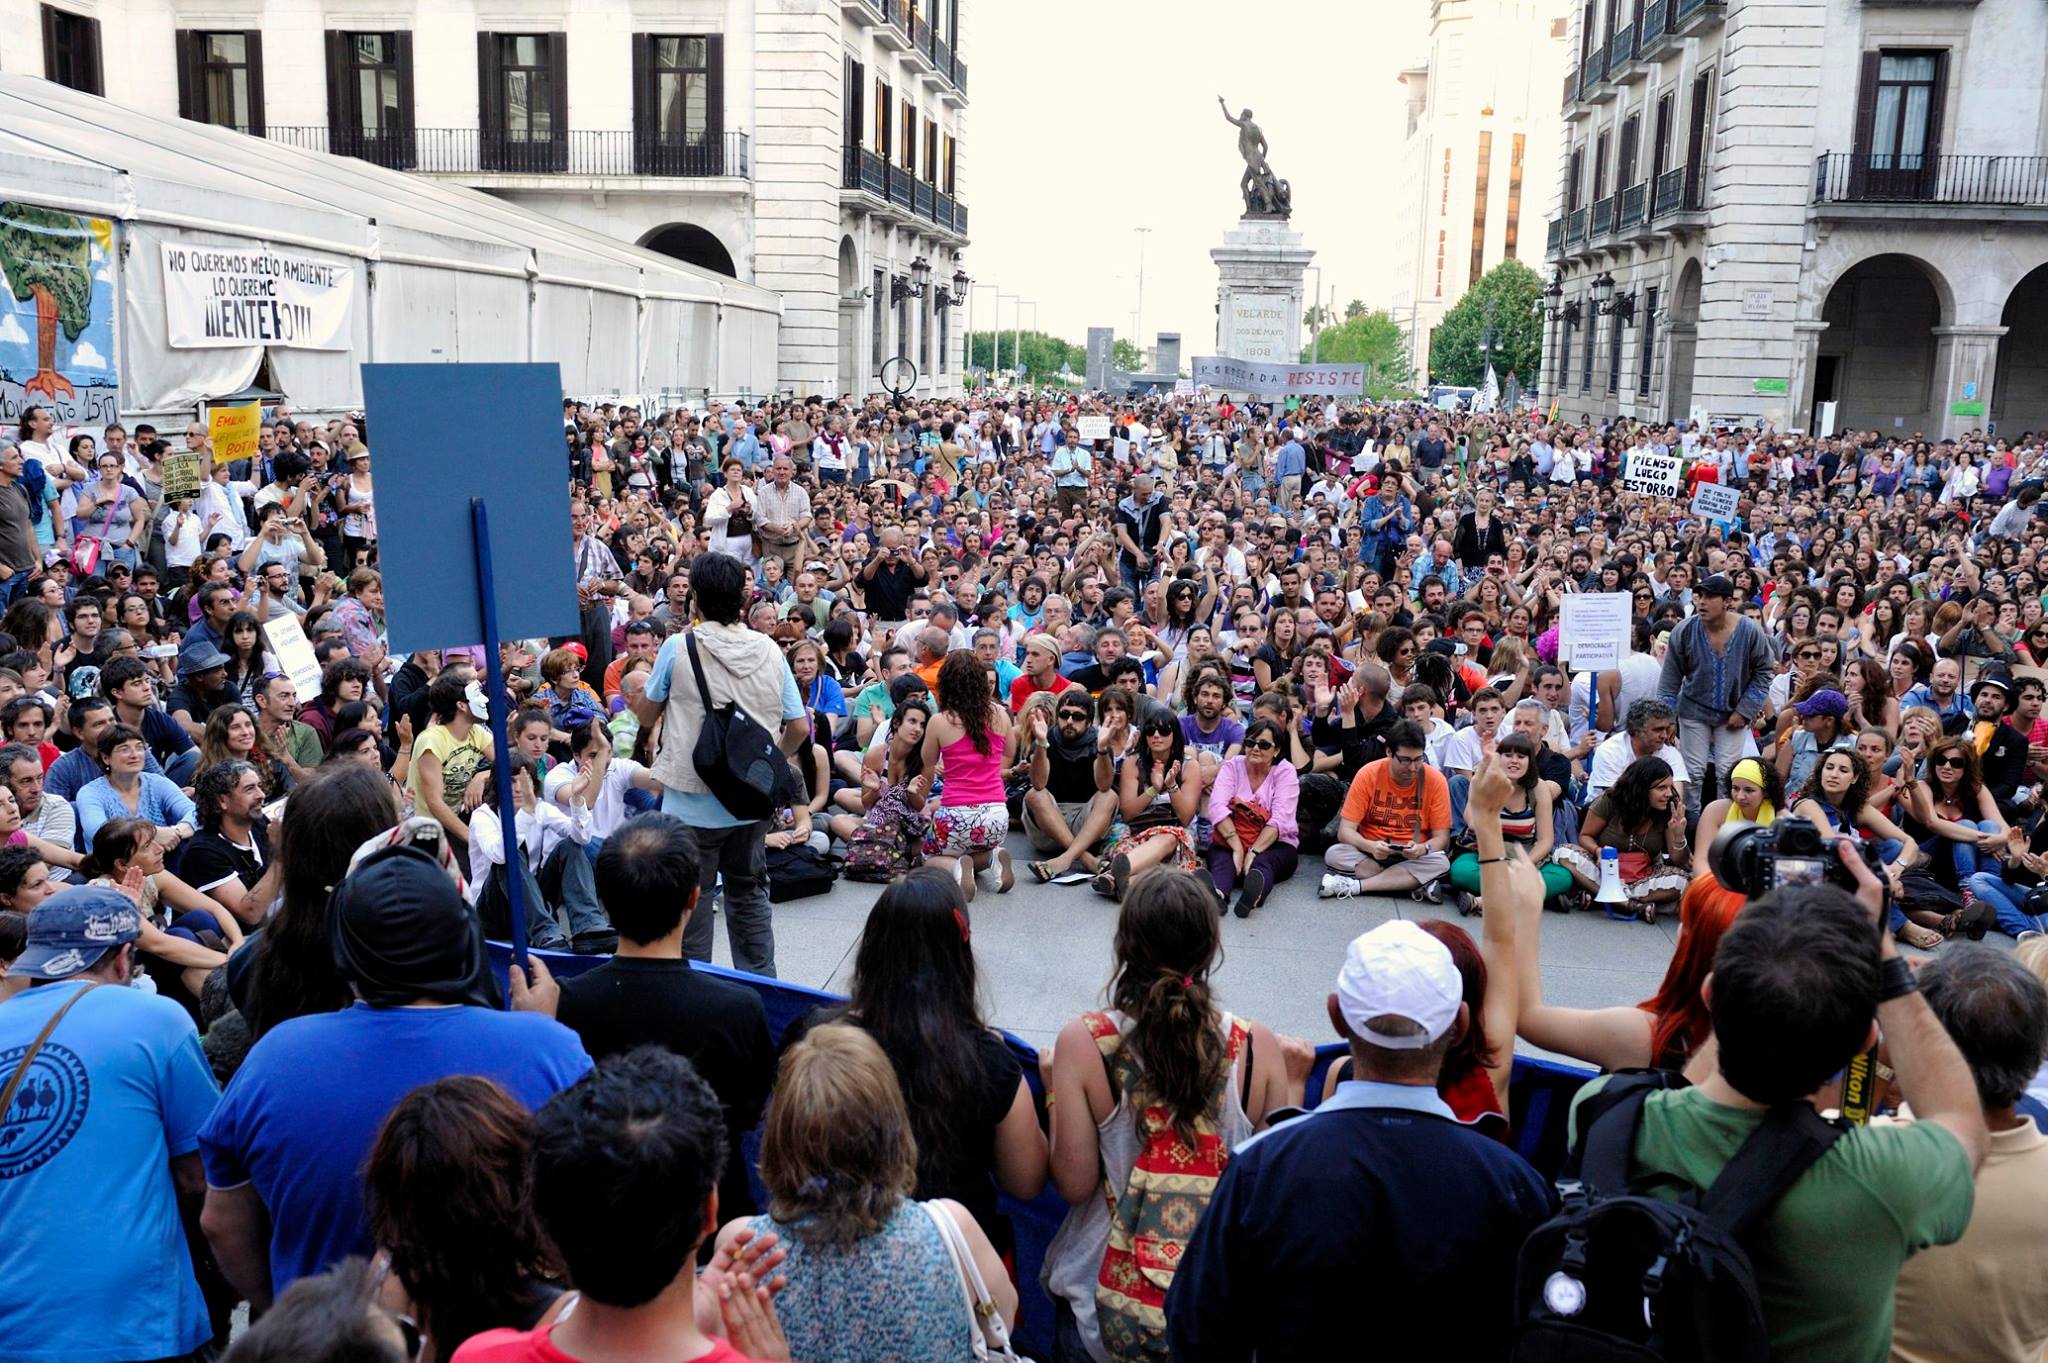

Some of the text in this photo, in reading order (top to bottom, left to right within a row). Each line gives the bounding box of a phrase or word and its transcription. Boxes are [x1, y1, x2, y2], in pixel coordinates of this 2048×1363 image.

[1441, 147, 1451, 217] HOTEL
[169, 251, 186, 272] NO
[191, 252, 247, 274] QUEREMOS
[213, 277, 226, 297] LO
[1236, 309, 1283, 319] VELARDE
[1246, 348, 1271, 356] 1808
[1288, 371, 1362, 386] RESISTE
[1633, 455, 1675, 470] PIENSO
[1635, 468, 1668, 480] LUEGO
[1623, 479, 1675, 497] ESTORBO
[1847, 1053, 1869, 1104] Nikon
